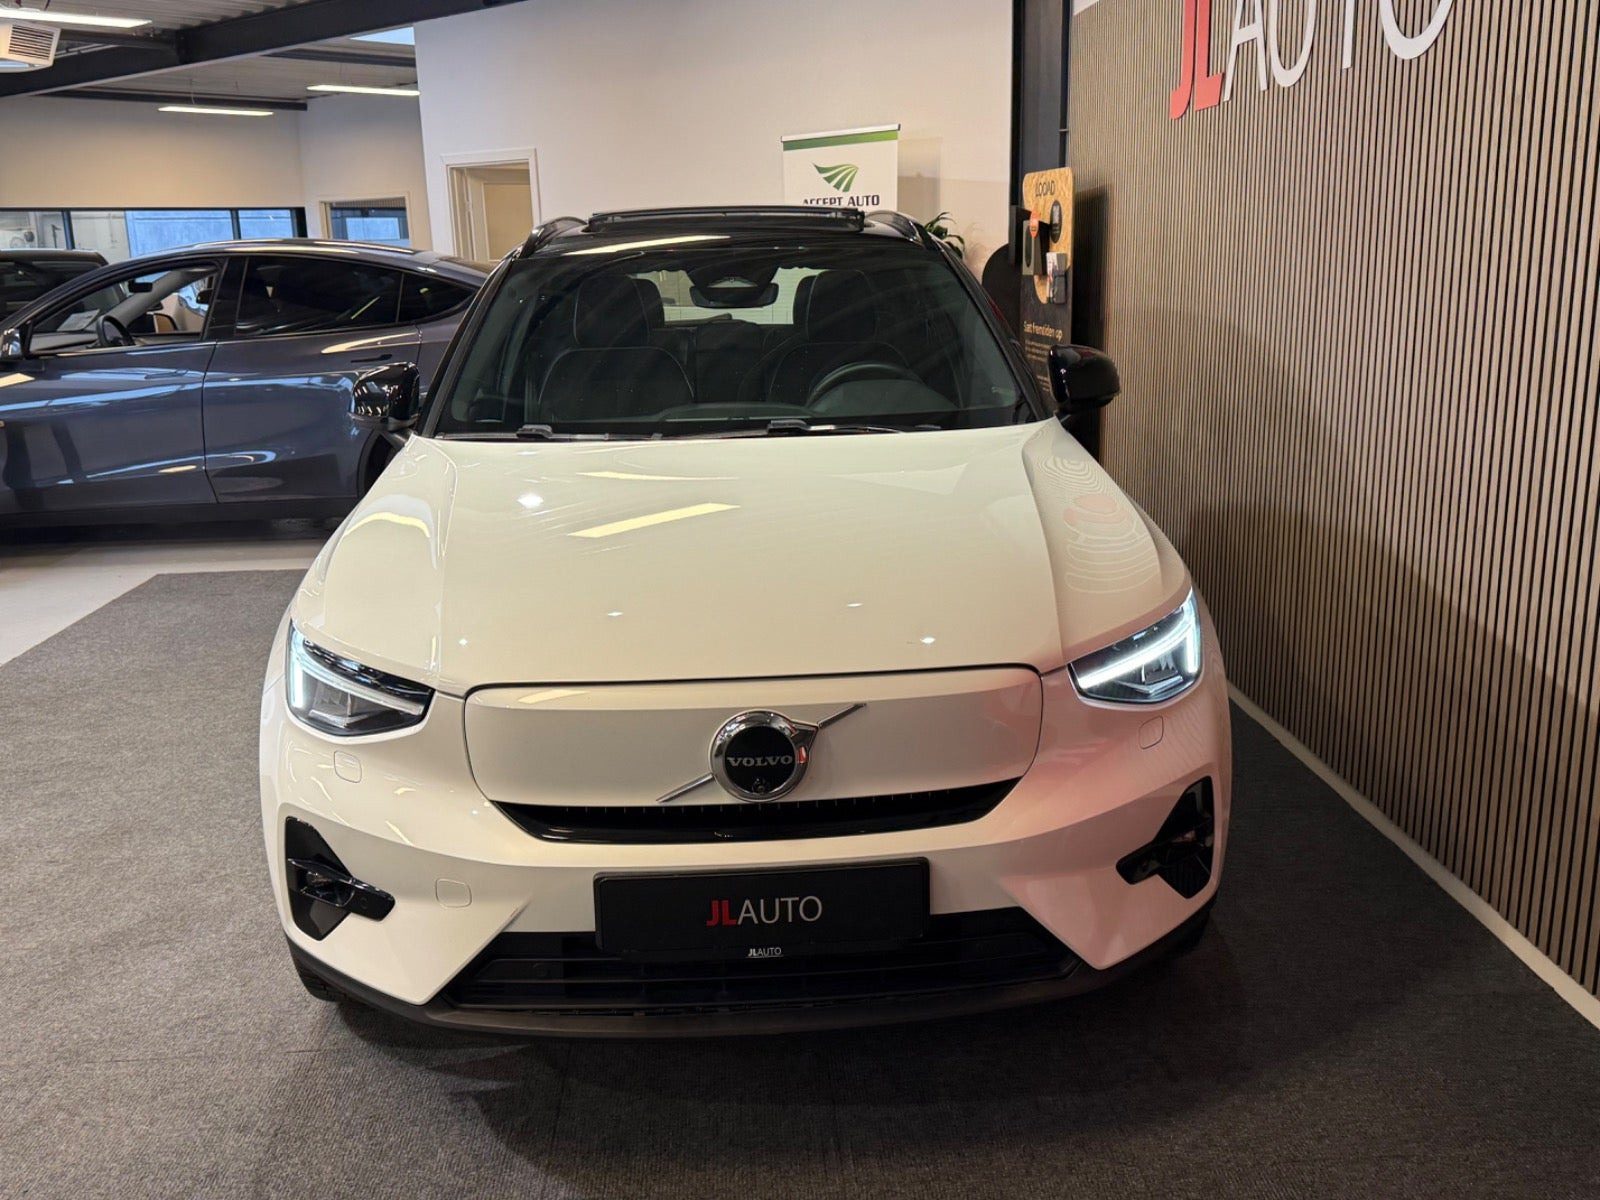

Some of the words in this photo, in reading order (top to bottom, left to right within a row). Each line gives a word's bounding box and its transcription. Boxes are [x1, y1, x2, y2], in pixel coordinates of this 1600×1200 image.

[1169, 0, 1452, 120] JLA
[847, 194, 880, 206] AUTO
[726, 755, 793, 767] VOLVO
[706, 896, 823, 927] JLAUTO
[748, 947, 782, 957] JLAUTO
